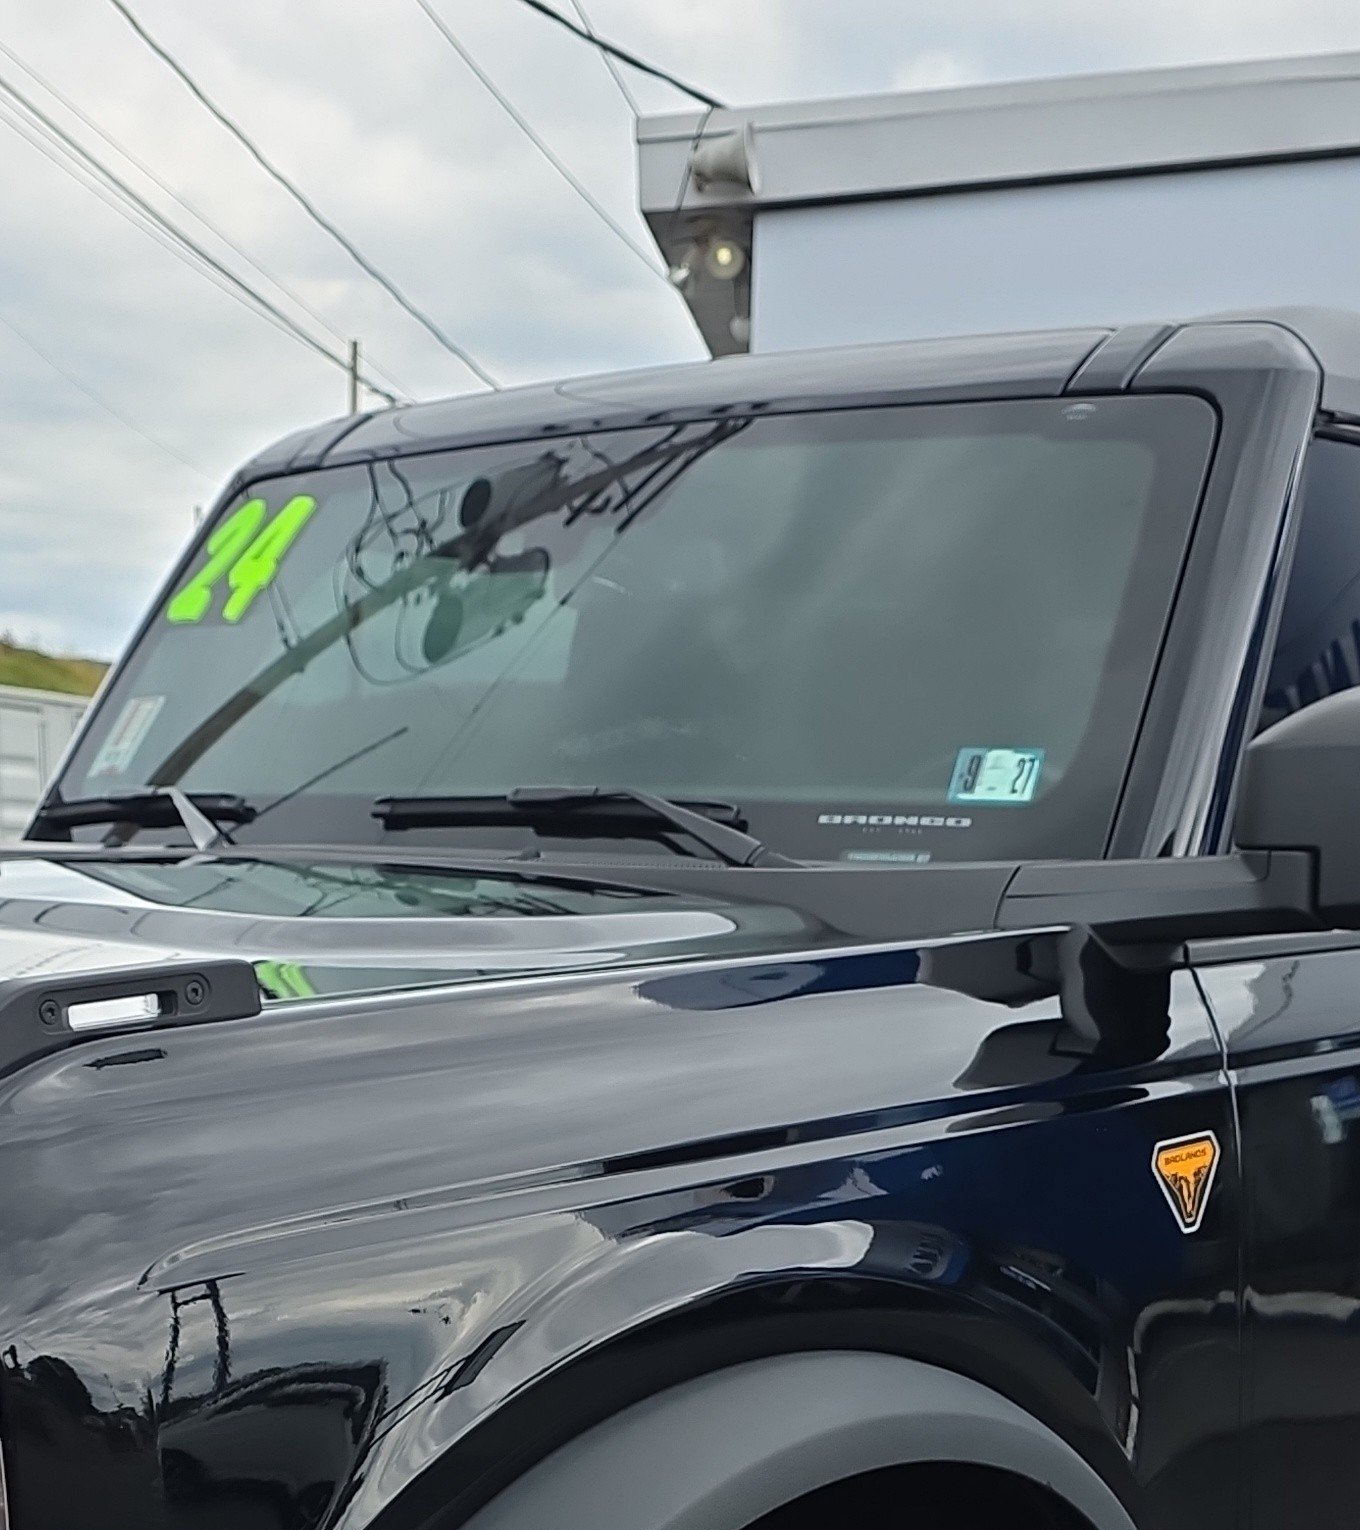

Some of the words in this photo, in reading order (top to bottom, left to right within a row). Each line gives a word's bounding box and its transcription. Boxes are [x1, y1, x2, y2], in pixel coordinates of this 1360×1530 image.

[166, 496, 317, 623] 24
[1010, 757, 1037, 794] 27
[817, 814, 973, 828] BRONCO
